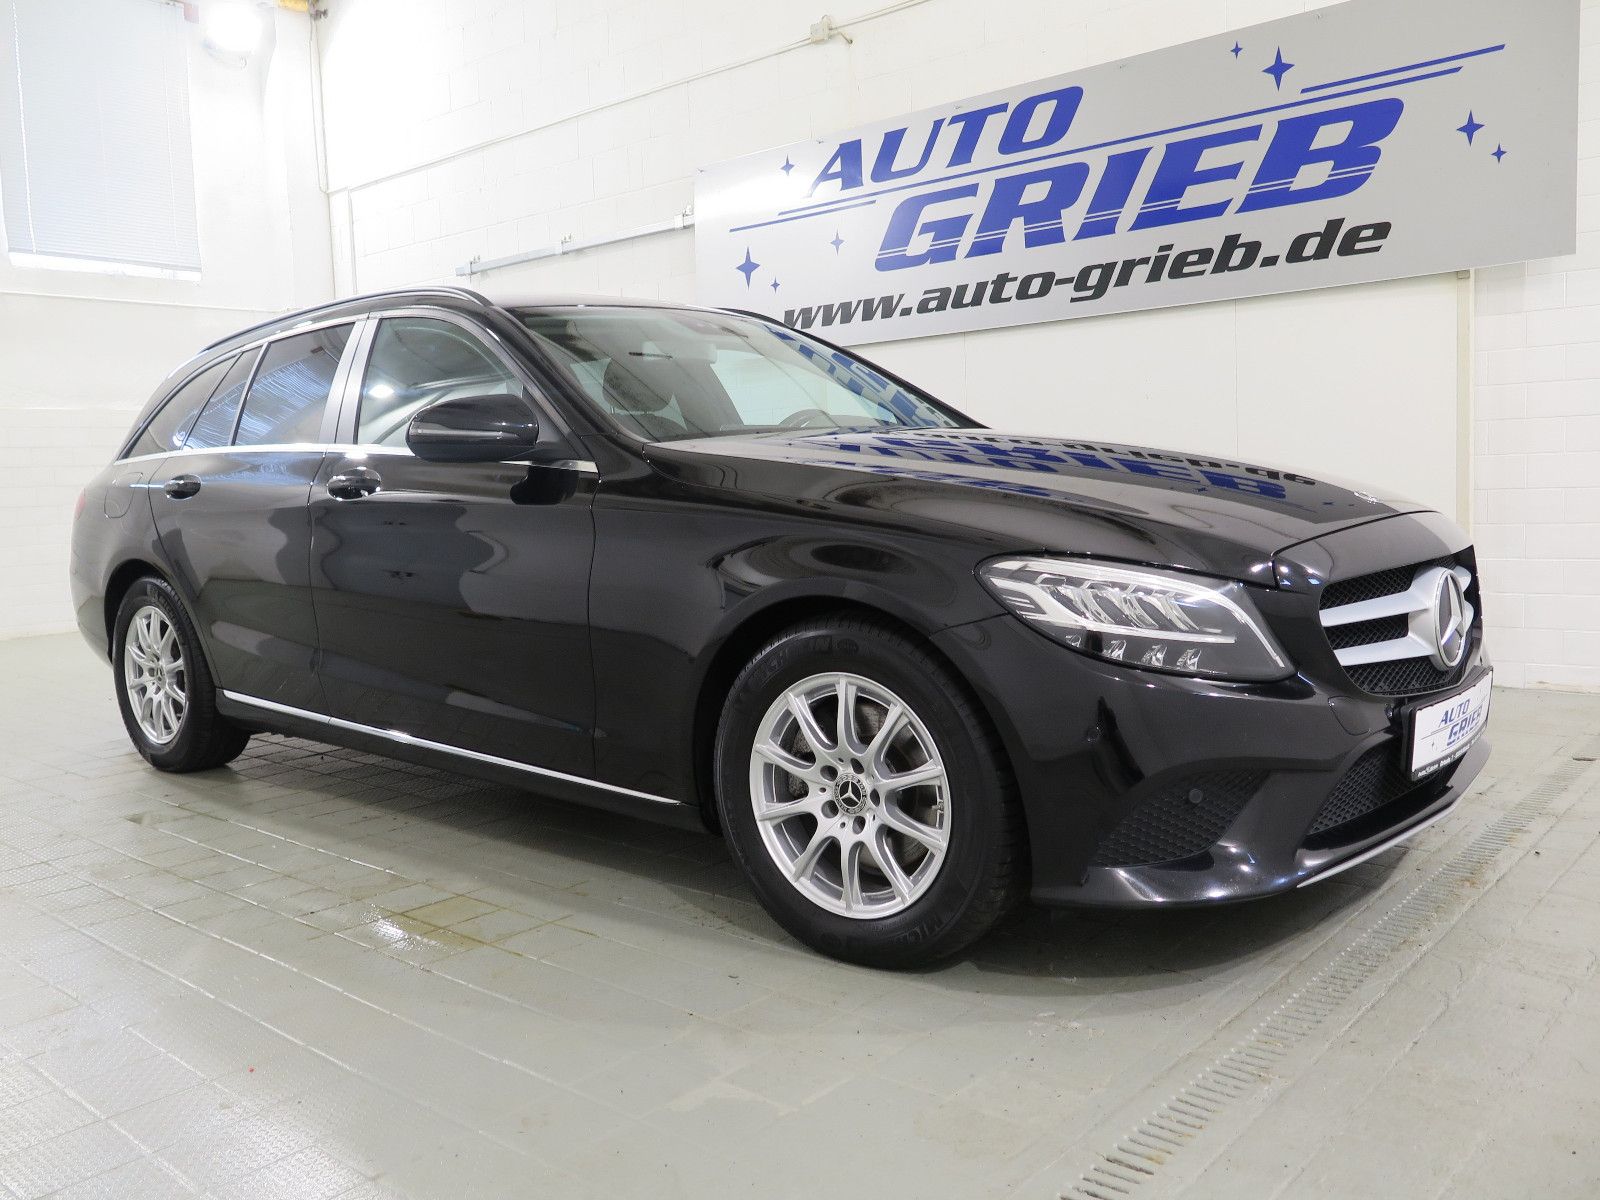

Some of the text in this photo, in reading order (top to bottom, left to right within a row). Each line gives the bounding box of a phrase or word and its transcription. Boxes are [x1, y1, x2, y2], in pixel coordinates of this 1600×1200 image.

[809, 86, 1083, 197] AUTO
[875, 98, 1405, 271] GRIEB
[783, 217, 1392, 330] www.auto-grieb.de
[1440, 699, 1470, 725] AUTO
